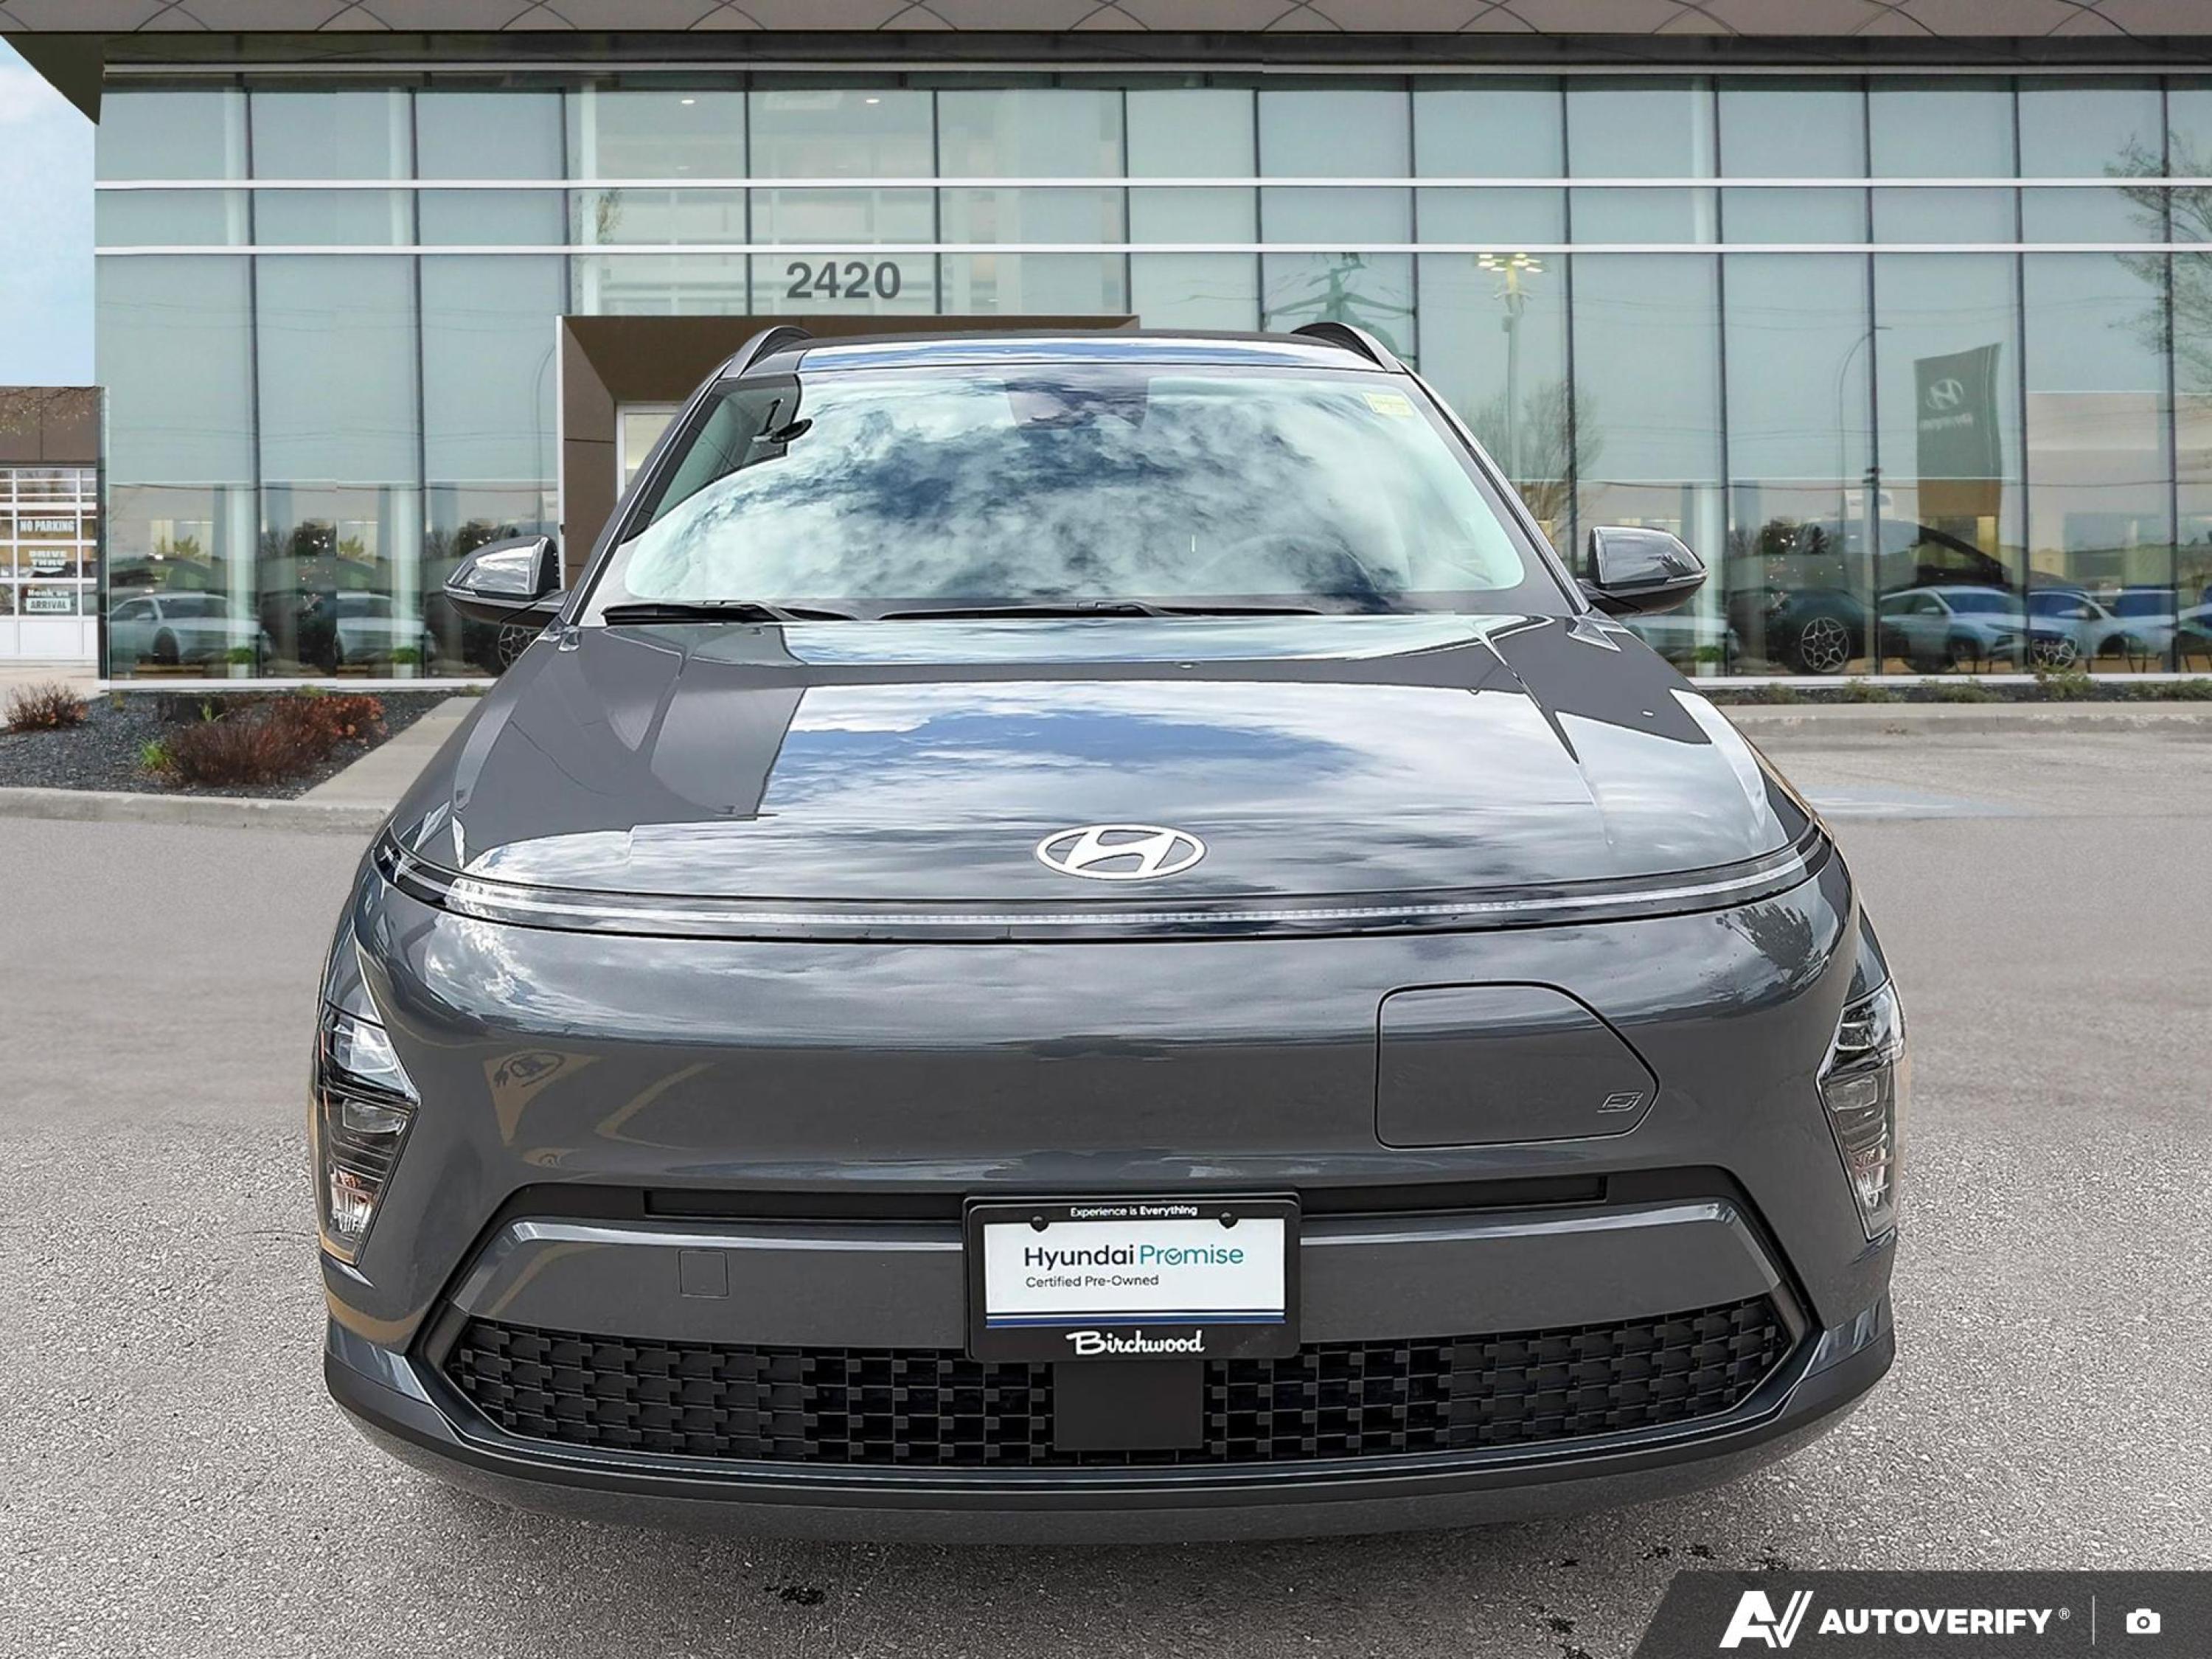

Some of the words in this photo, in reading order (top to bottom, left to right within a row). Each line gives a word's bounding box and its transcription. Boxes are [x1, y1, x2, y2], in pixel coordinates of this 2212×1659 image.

[786, 261, 901, 299] 2420
[20, 520, 33, 532] NO
[34, 520, 74, 532] PARKING
[30, 600, 67, 609] ARRIVAL
[1071, 1206, 1127, 1218] Experience
[1130, 1206, 1137, 1215] is
[1140, 1205, 1197, 1217] Everything
[1025, 1244, 1134, 1270] Hyundai
[1140, 1244, 1244, 1265] Promise
[1026, 1276, 1081, 1287] Certified
[1085, 1274, 1159, 1287] Pre-Owned
[1065, 1329, 1205, 1355] Birchwood
